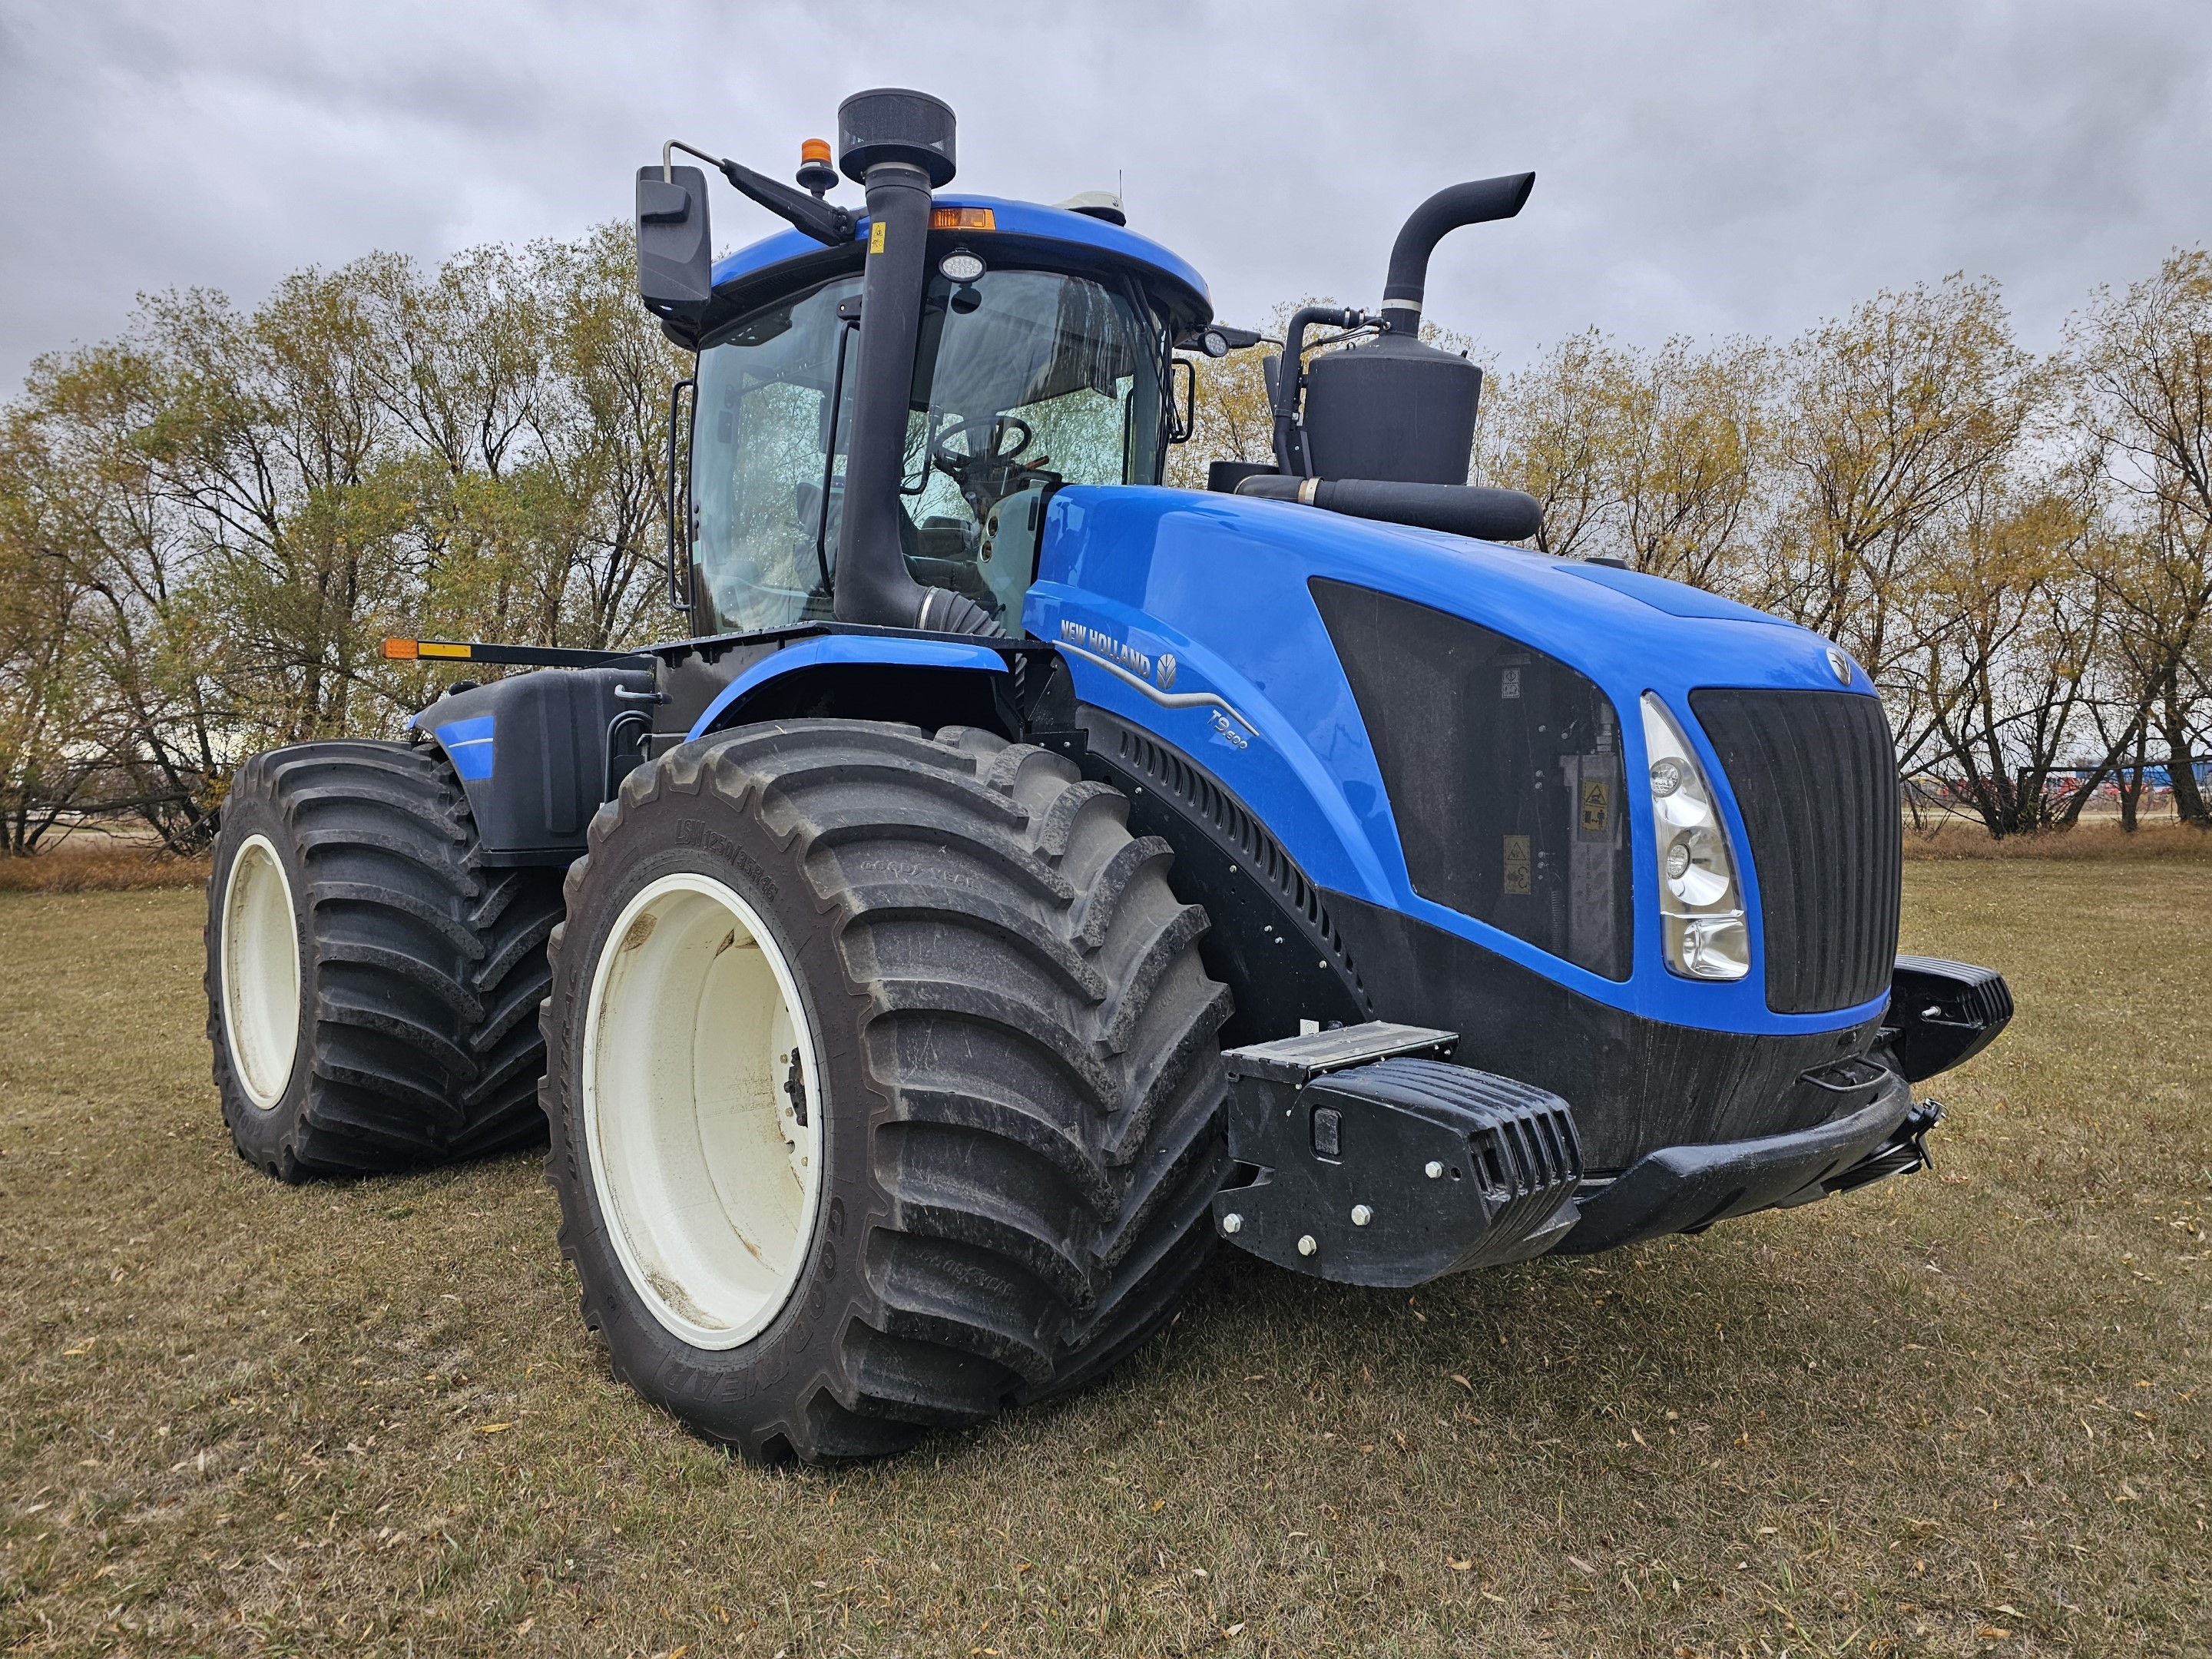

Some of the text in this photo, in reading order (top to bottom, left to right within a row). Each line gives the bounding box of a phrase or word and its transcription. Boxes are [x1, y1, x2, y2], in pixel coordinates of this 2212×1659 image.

[1061, 619, 1151, 680] NEW HOLLAND
[559, 962, 578, 1181] OPTITRAC
[663, 1194, 846, 1403] GOODYEAR
